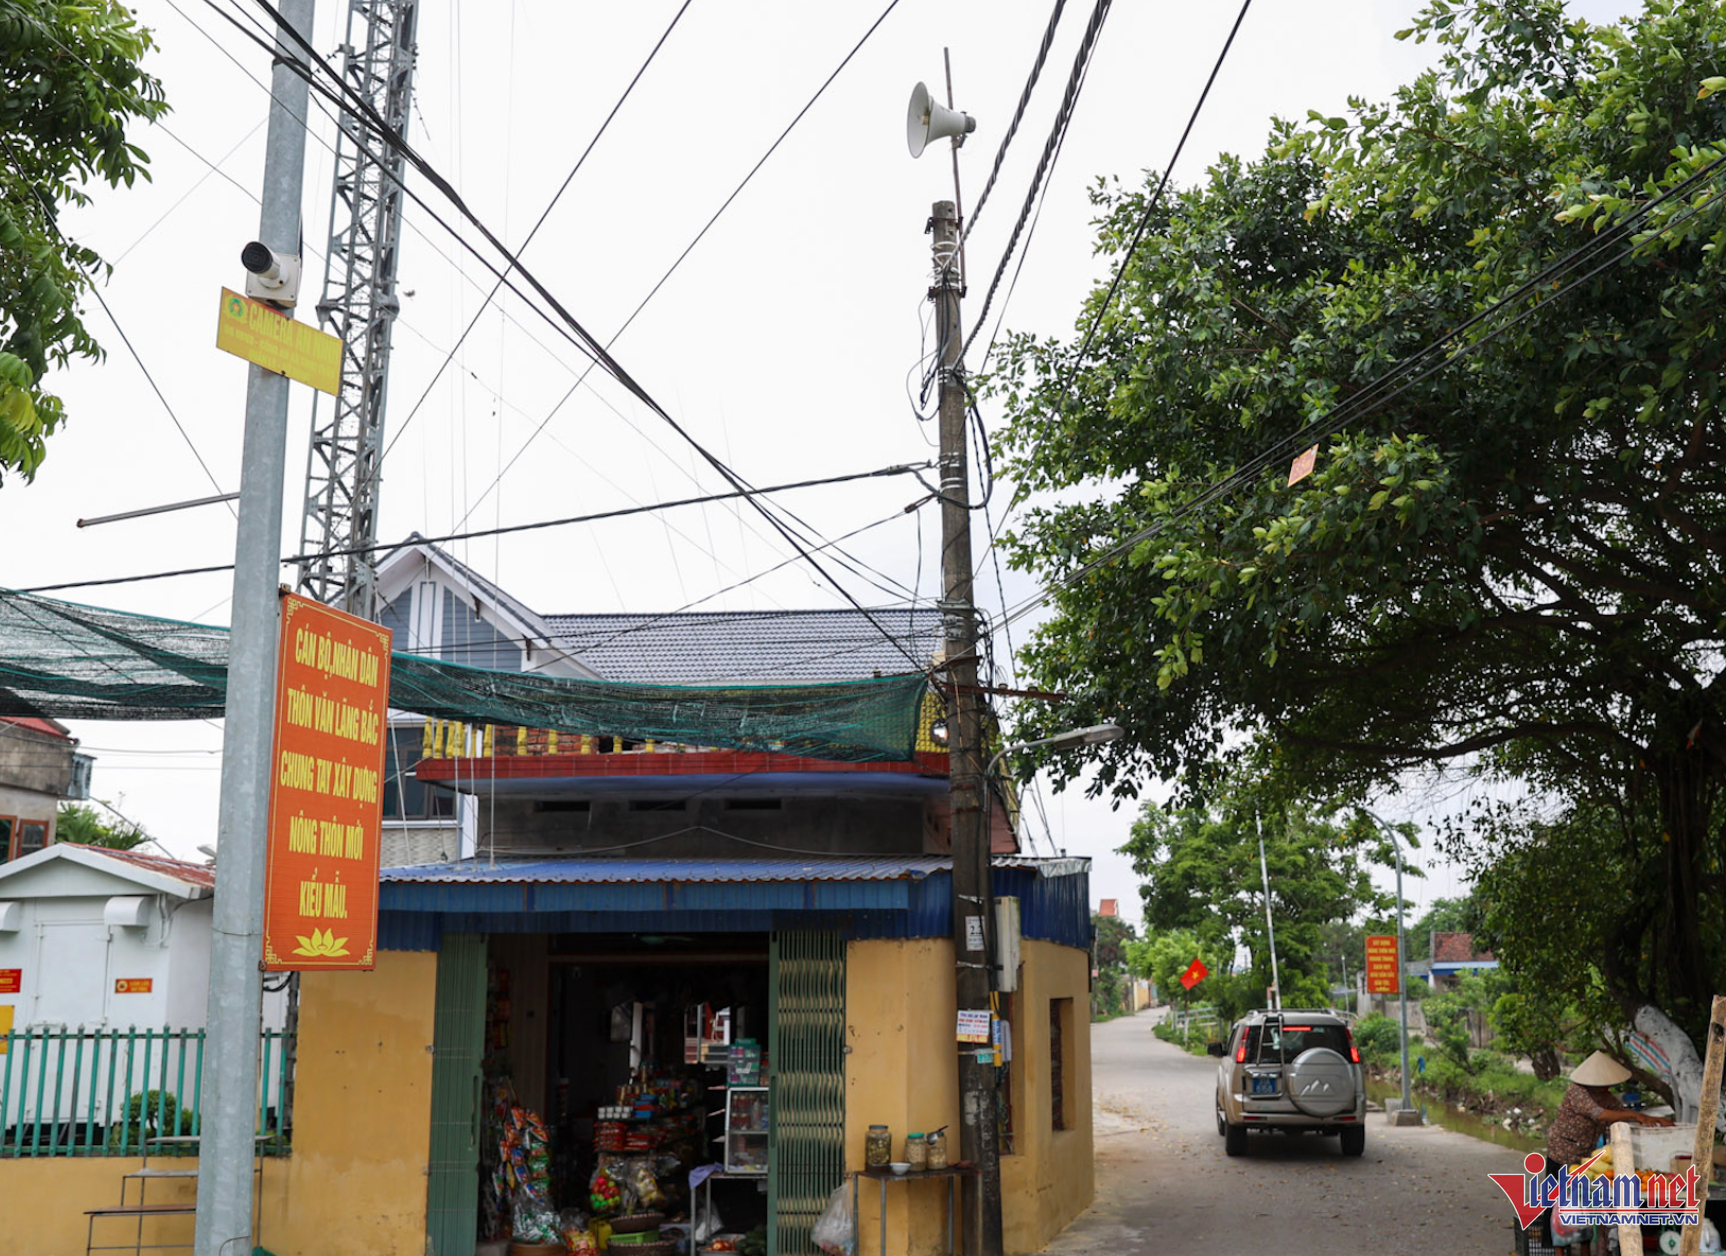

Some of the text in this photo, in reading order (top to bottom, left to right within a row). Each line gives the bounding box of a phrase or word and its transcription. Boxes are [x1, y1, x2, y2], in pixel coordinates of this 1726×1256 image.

[249, 303, 294, 347] CAMERA
[295, 623, 317, 668] CÁN
[359, 646, 379, 688] DÂN
[287, 684, 314, 729] THÔN
[315, 690, 334, 735] VĂN
[360, 699, 379, 746] BẮC
[280, 749, 378, 809] CHUNG TAY XÂY DỰNG
[289, 809, 364, 861] NÔNG THÔN MỚI
[299, 866, 323, 918] KIỂU
